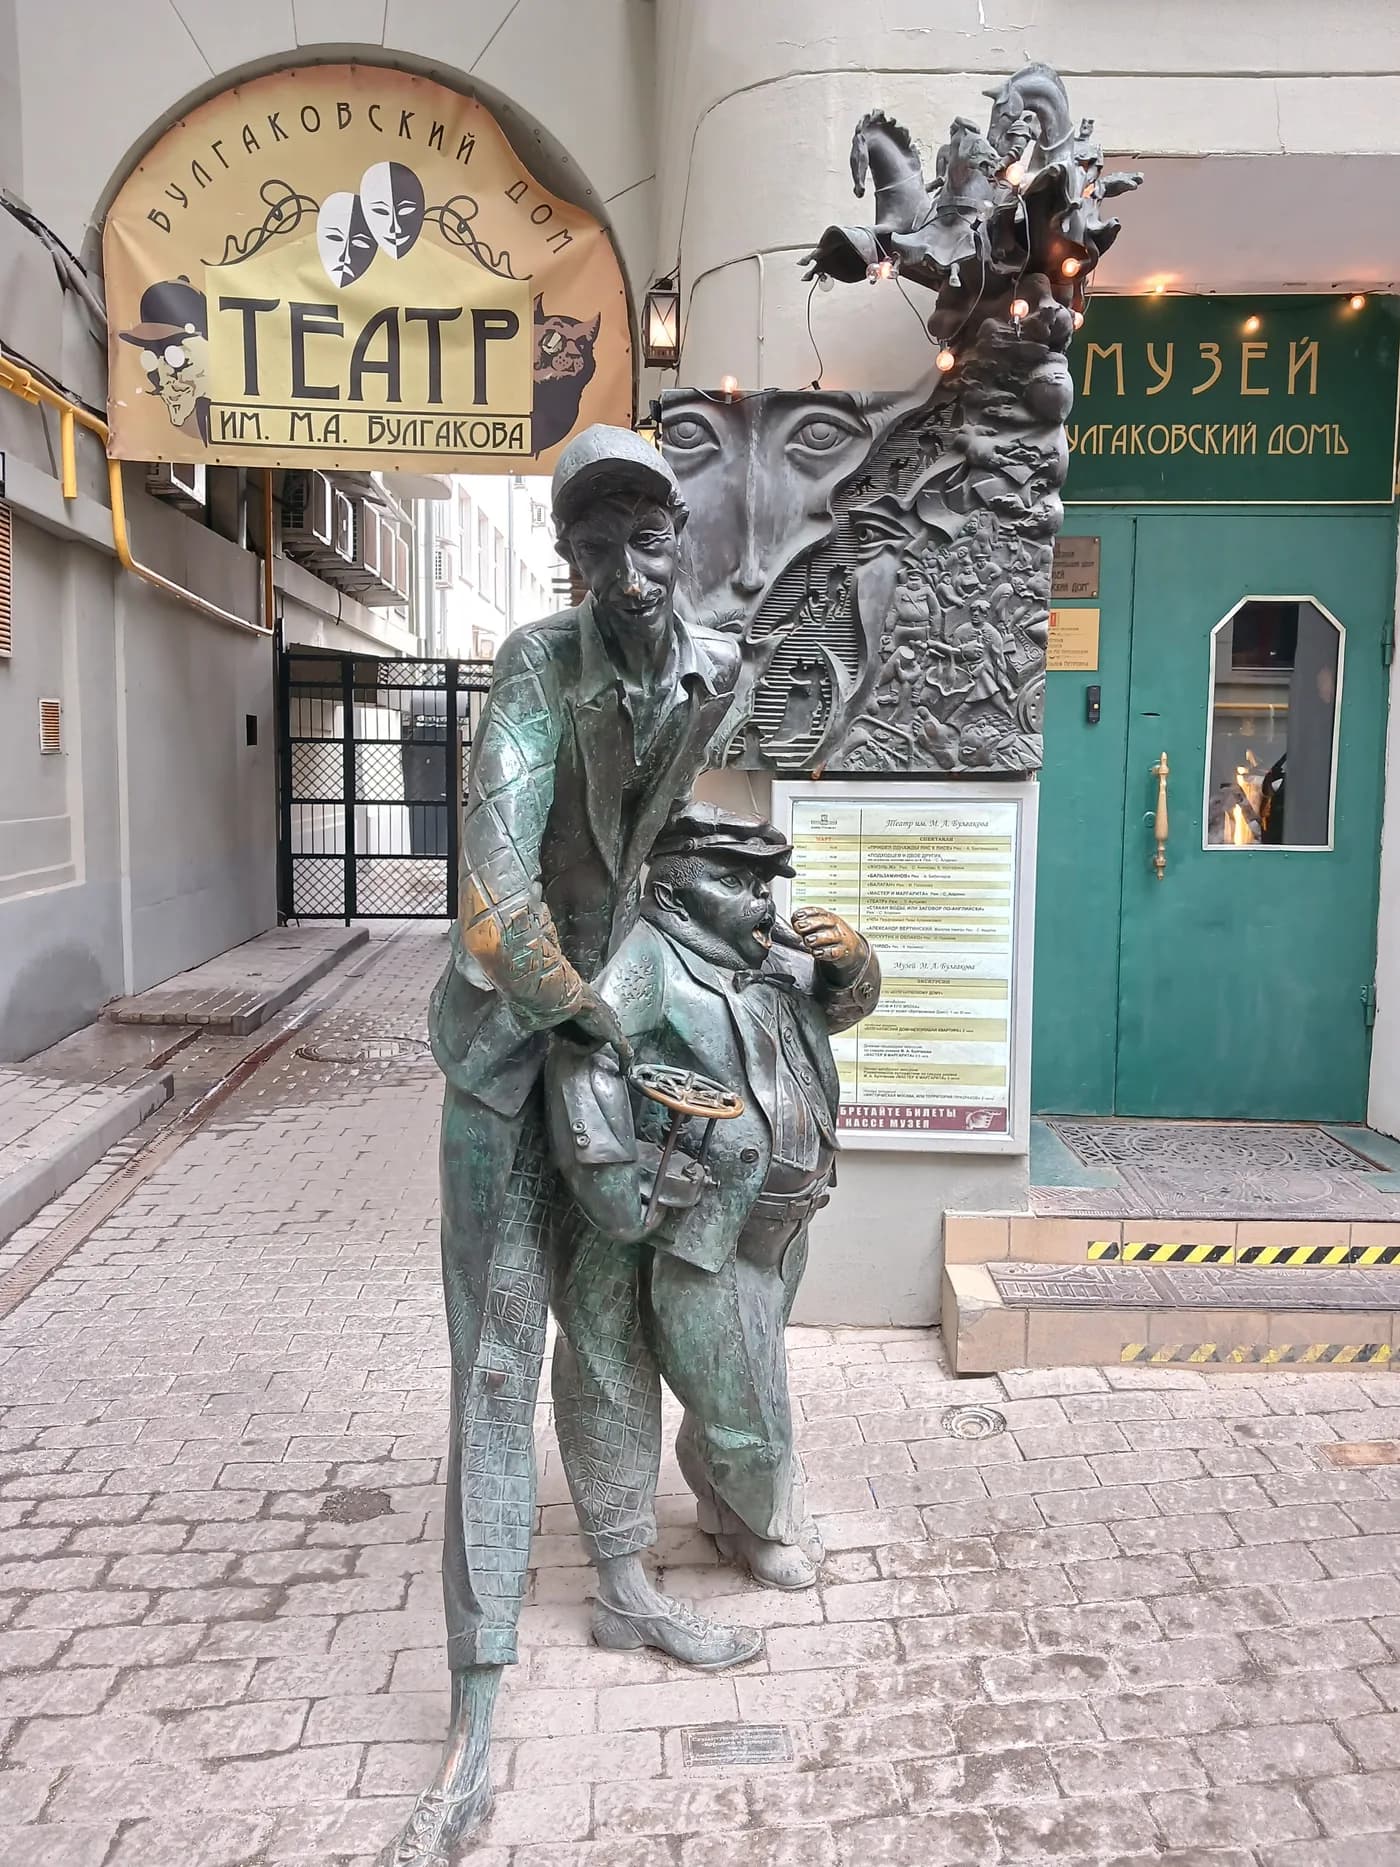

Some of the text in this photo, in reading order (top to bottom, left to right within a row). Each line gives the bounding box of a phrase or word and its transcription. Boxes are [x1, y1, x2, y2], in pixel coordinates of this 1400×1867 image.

[147, 101, 574, 253] БУЛГАКОВСКИЙ ДОМ
[219, 295, 520, 405] ТЕАТР
[1082, 337, 1319, 395] МУЗЕЙ
[220, 411, 524, 449] ИМ. М.А. БУЛГАКОВА
[1065, 421, 1349, 455] УЛГАКОВСКИЙ ДОМЪ
[885, 819, 913, 829] Театр
[952, 820, 989, 829] Булгакова
[893, 961, 916, 971] Музей
[840, 1104, 957, 1118] БРЕТАЙТЕ БИЛЕТЫ
[845, 1118, 888, 1128] КАССЕ
